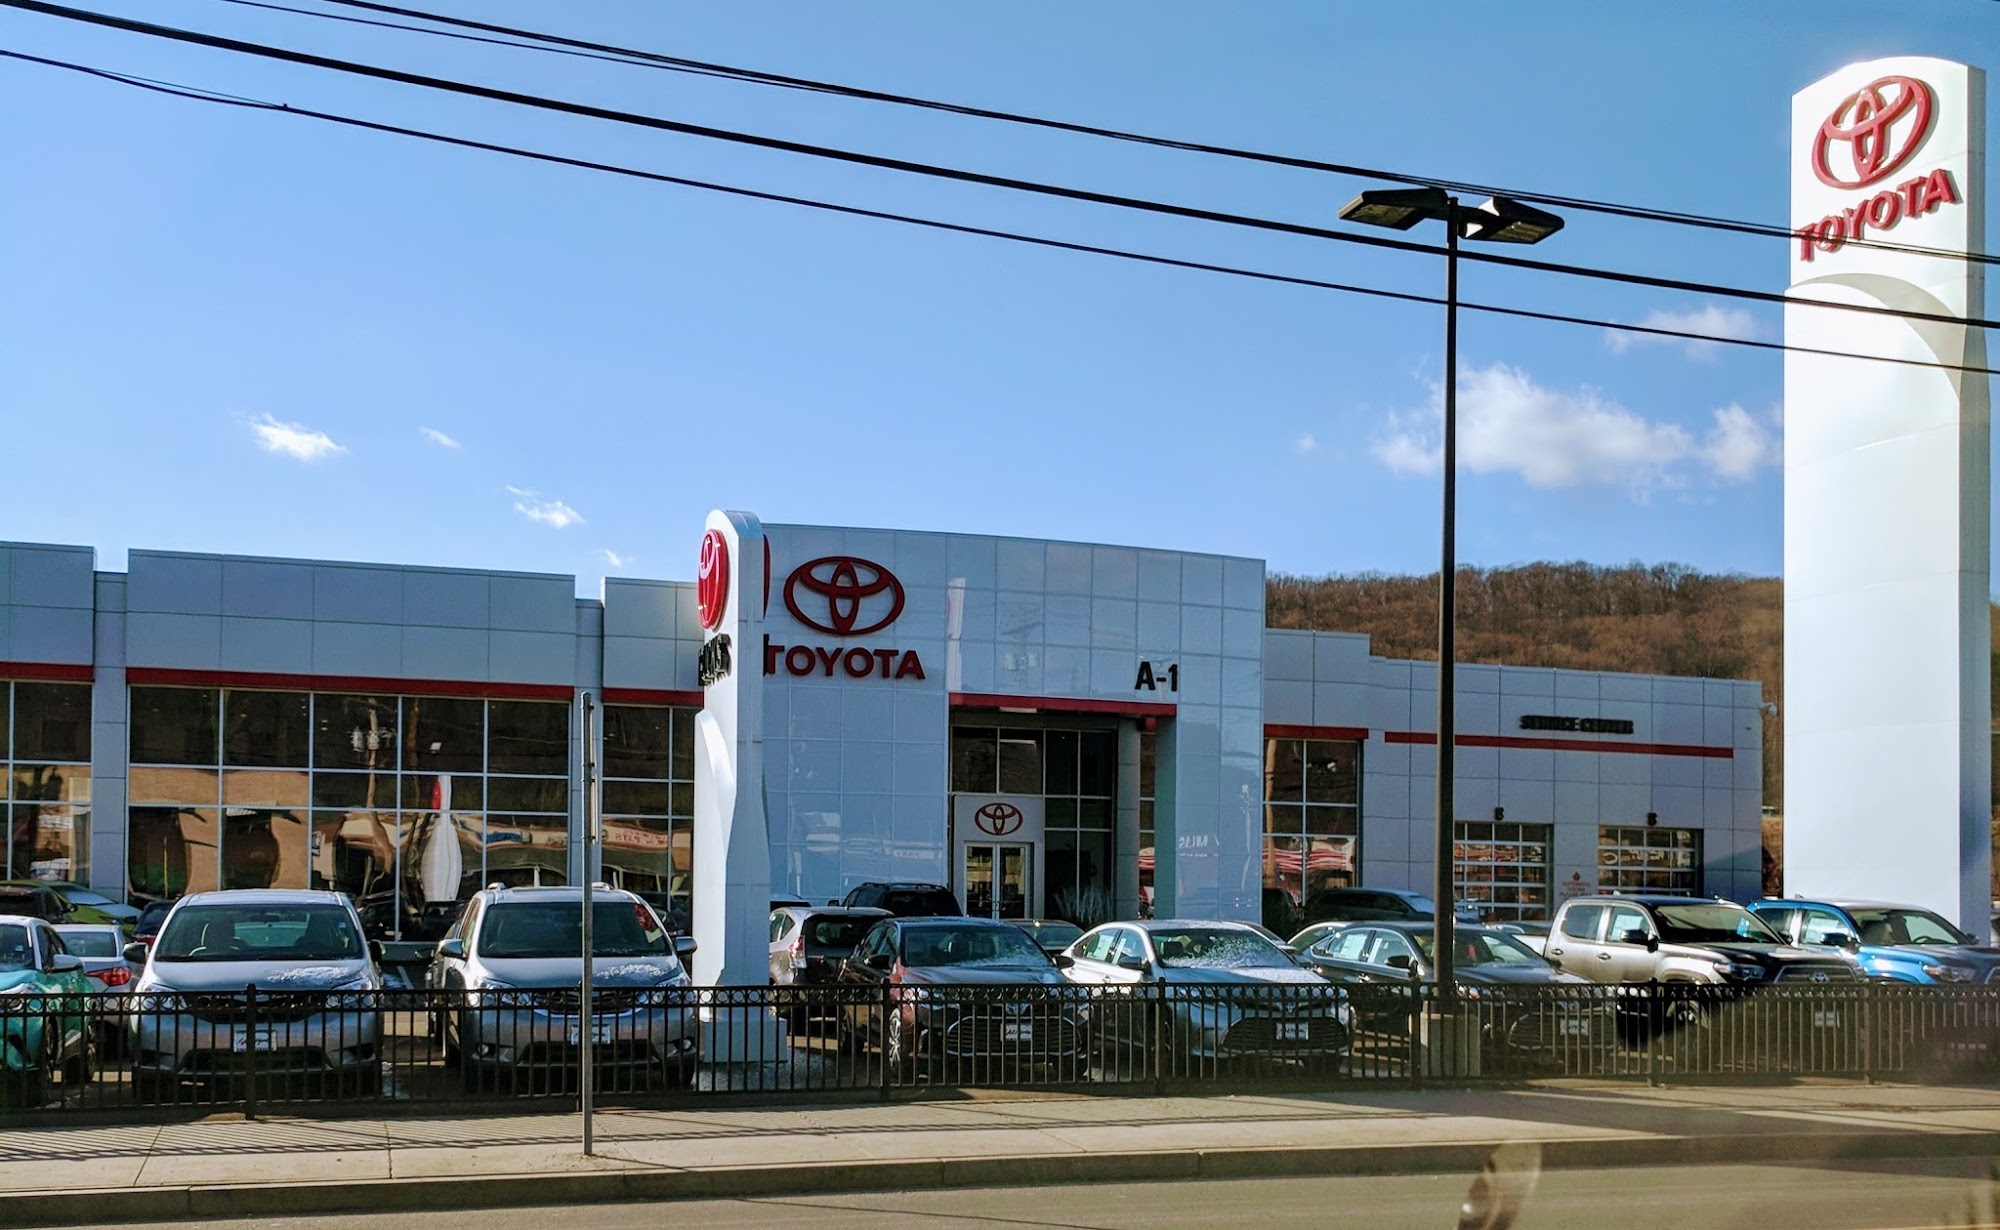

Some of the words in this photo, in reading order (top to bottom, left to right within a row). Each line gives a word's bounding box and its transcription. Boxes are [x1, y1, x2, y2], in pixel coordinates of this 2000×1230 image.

[1794, 168, 1957, 262] TOYOTA
[767, 645, 926, 680] TOYOTA
[1134, 661, 1178, 692] A-1
